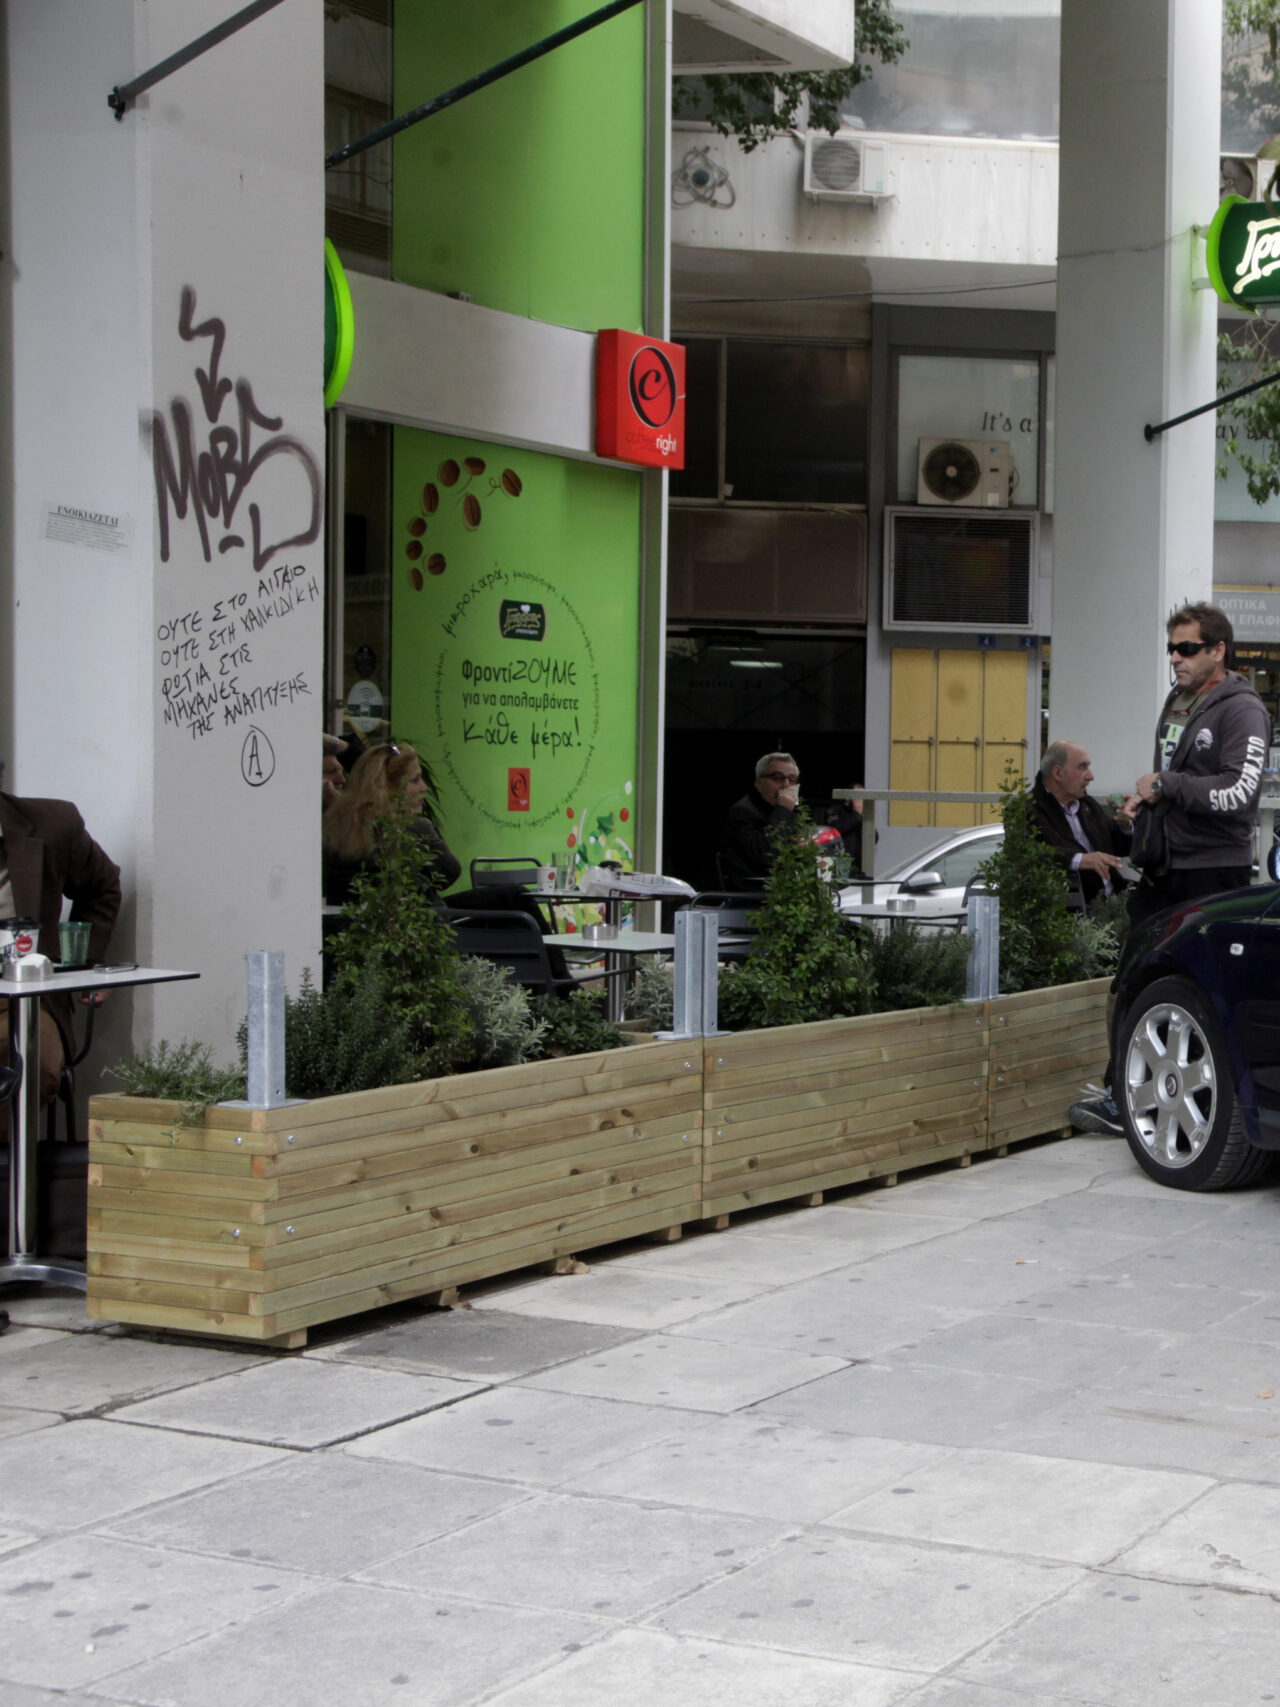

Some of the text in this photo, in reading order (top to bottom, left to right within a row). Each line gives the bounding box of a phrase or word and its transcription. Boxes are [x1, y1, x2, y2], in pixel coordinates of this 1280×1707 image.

[982, 411, 1013, 432] It's
[1019, 417, 1033, 433] a
[655, 432, 678, 456] right
[57, 504, 119, 527] ΕΝΟΙΚΙΑΖΕΤΑΙ
[158, 610, 202, 641] ΟΥΤΕ
[212, 593, 247, 622] ΣΤΟ
[161, 637, 200, 669] ΟΥΤΕ
[208, 622, 236, 652] ΣΤΗ
[240, 576, 320, 633] ΧΑΛΚΙΔΙΚΗ
[1219, 598, 1267, 611] ΟΠΤΙΚΑ
[219, 643, 253, 676] ΣΤΙΣ
[164, 677, 241, 727] ΜΗΧΑΝΕΣ
[186, 672, 313, 740] ΤΗΣ ΑΝΑΠΤΥΞΗΣ
[462, 691, 579, 712] για να απολαμβάνετε
[531, 715, 582, 760] μέρα!
[1209, 735, 1265, 812] OLYMPIACOS
